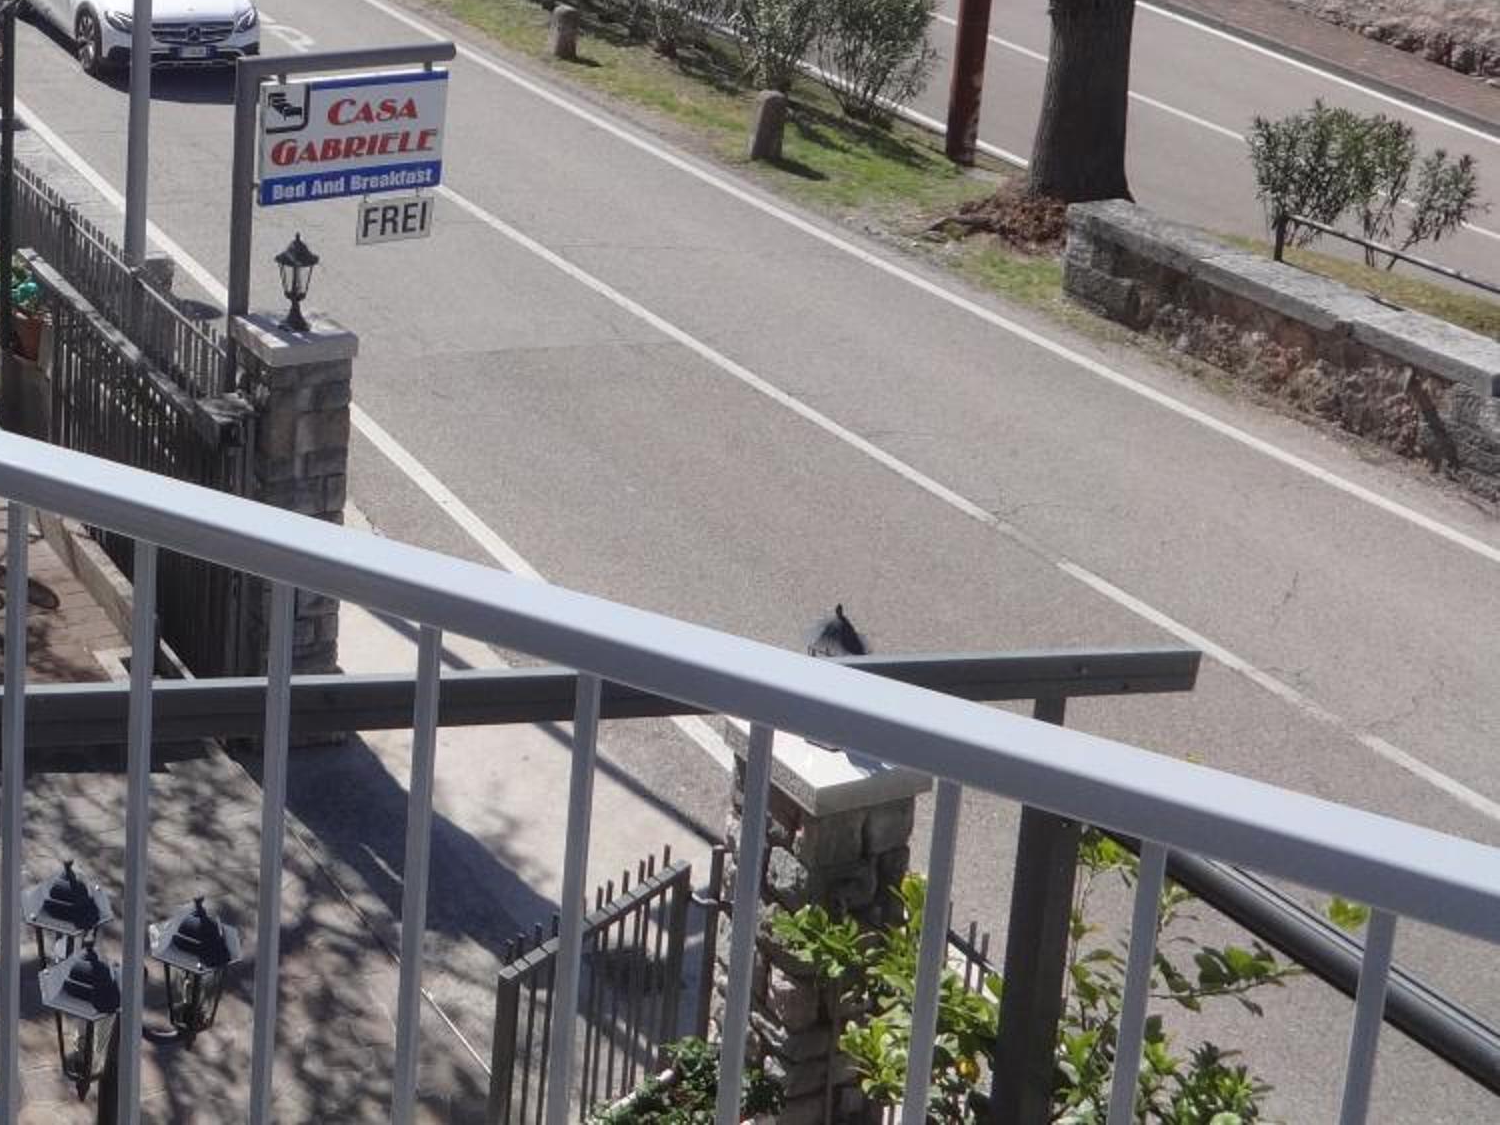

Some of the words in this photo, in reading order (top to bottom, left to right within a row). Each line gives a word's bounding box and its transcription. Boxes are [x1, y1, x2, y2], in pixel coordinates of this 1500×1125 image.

[327, 98, 418, 126] CASA
[271, 129, 438, 166] GABRIELE
[272, 183, 305, 200] Bed
[311, 177, 345, 195] And
[350, 169, 433, 191] Breakfast
[362, 201, 428, 238] FREI
